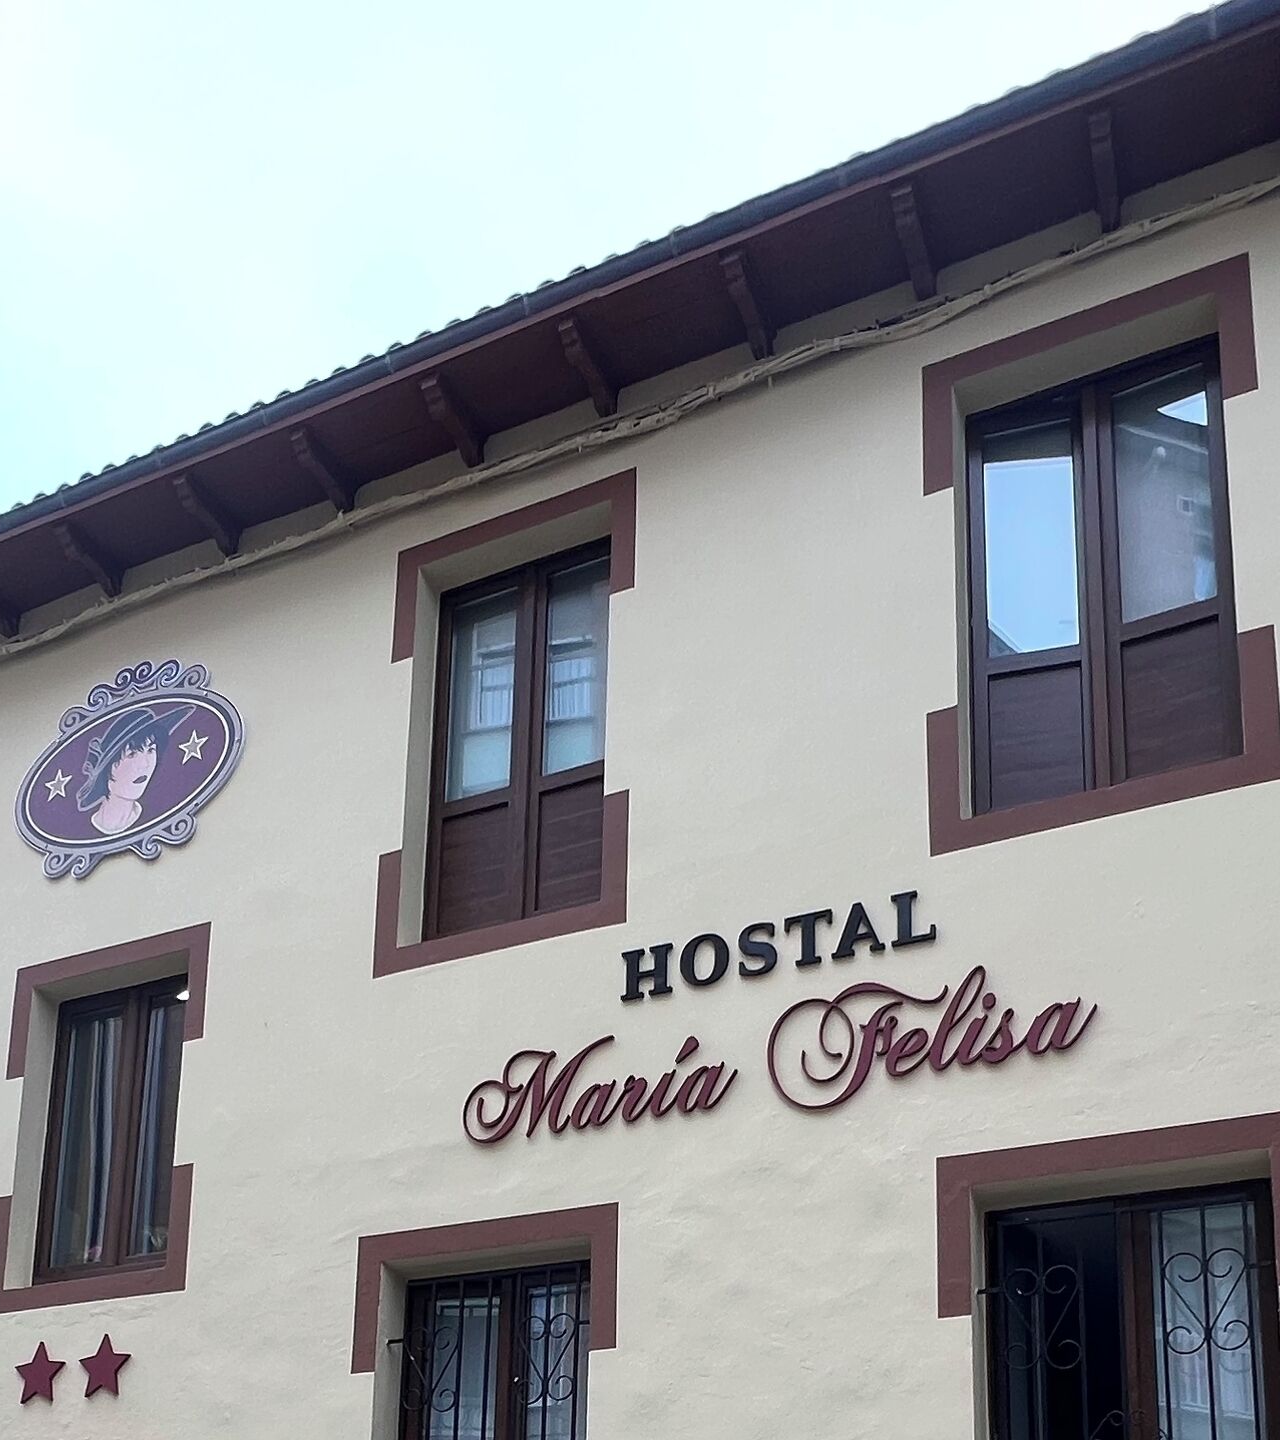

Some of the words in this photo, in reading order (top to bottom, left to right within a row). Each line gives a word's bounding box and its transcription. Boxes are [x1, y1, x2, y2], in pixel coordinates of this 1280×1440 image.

[621, 889, 937, 1002] HOSTAL
[463, 1034, 739, 1145] María
[766, 964, 1098, 1109] Felisa
